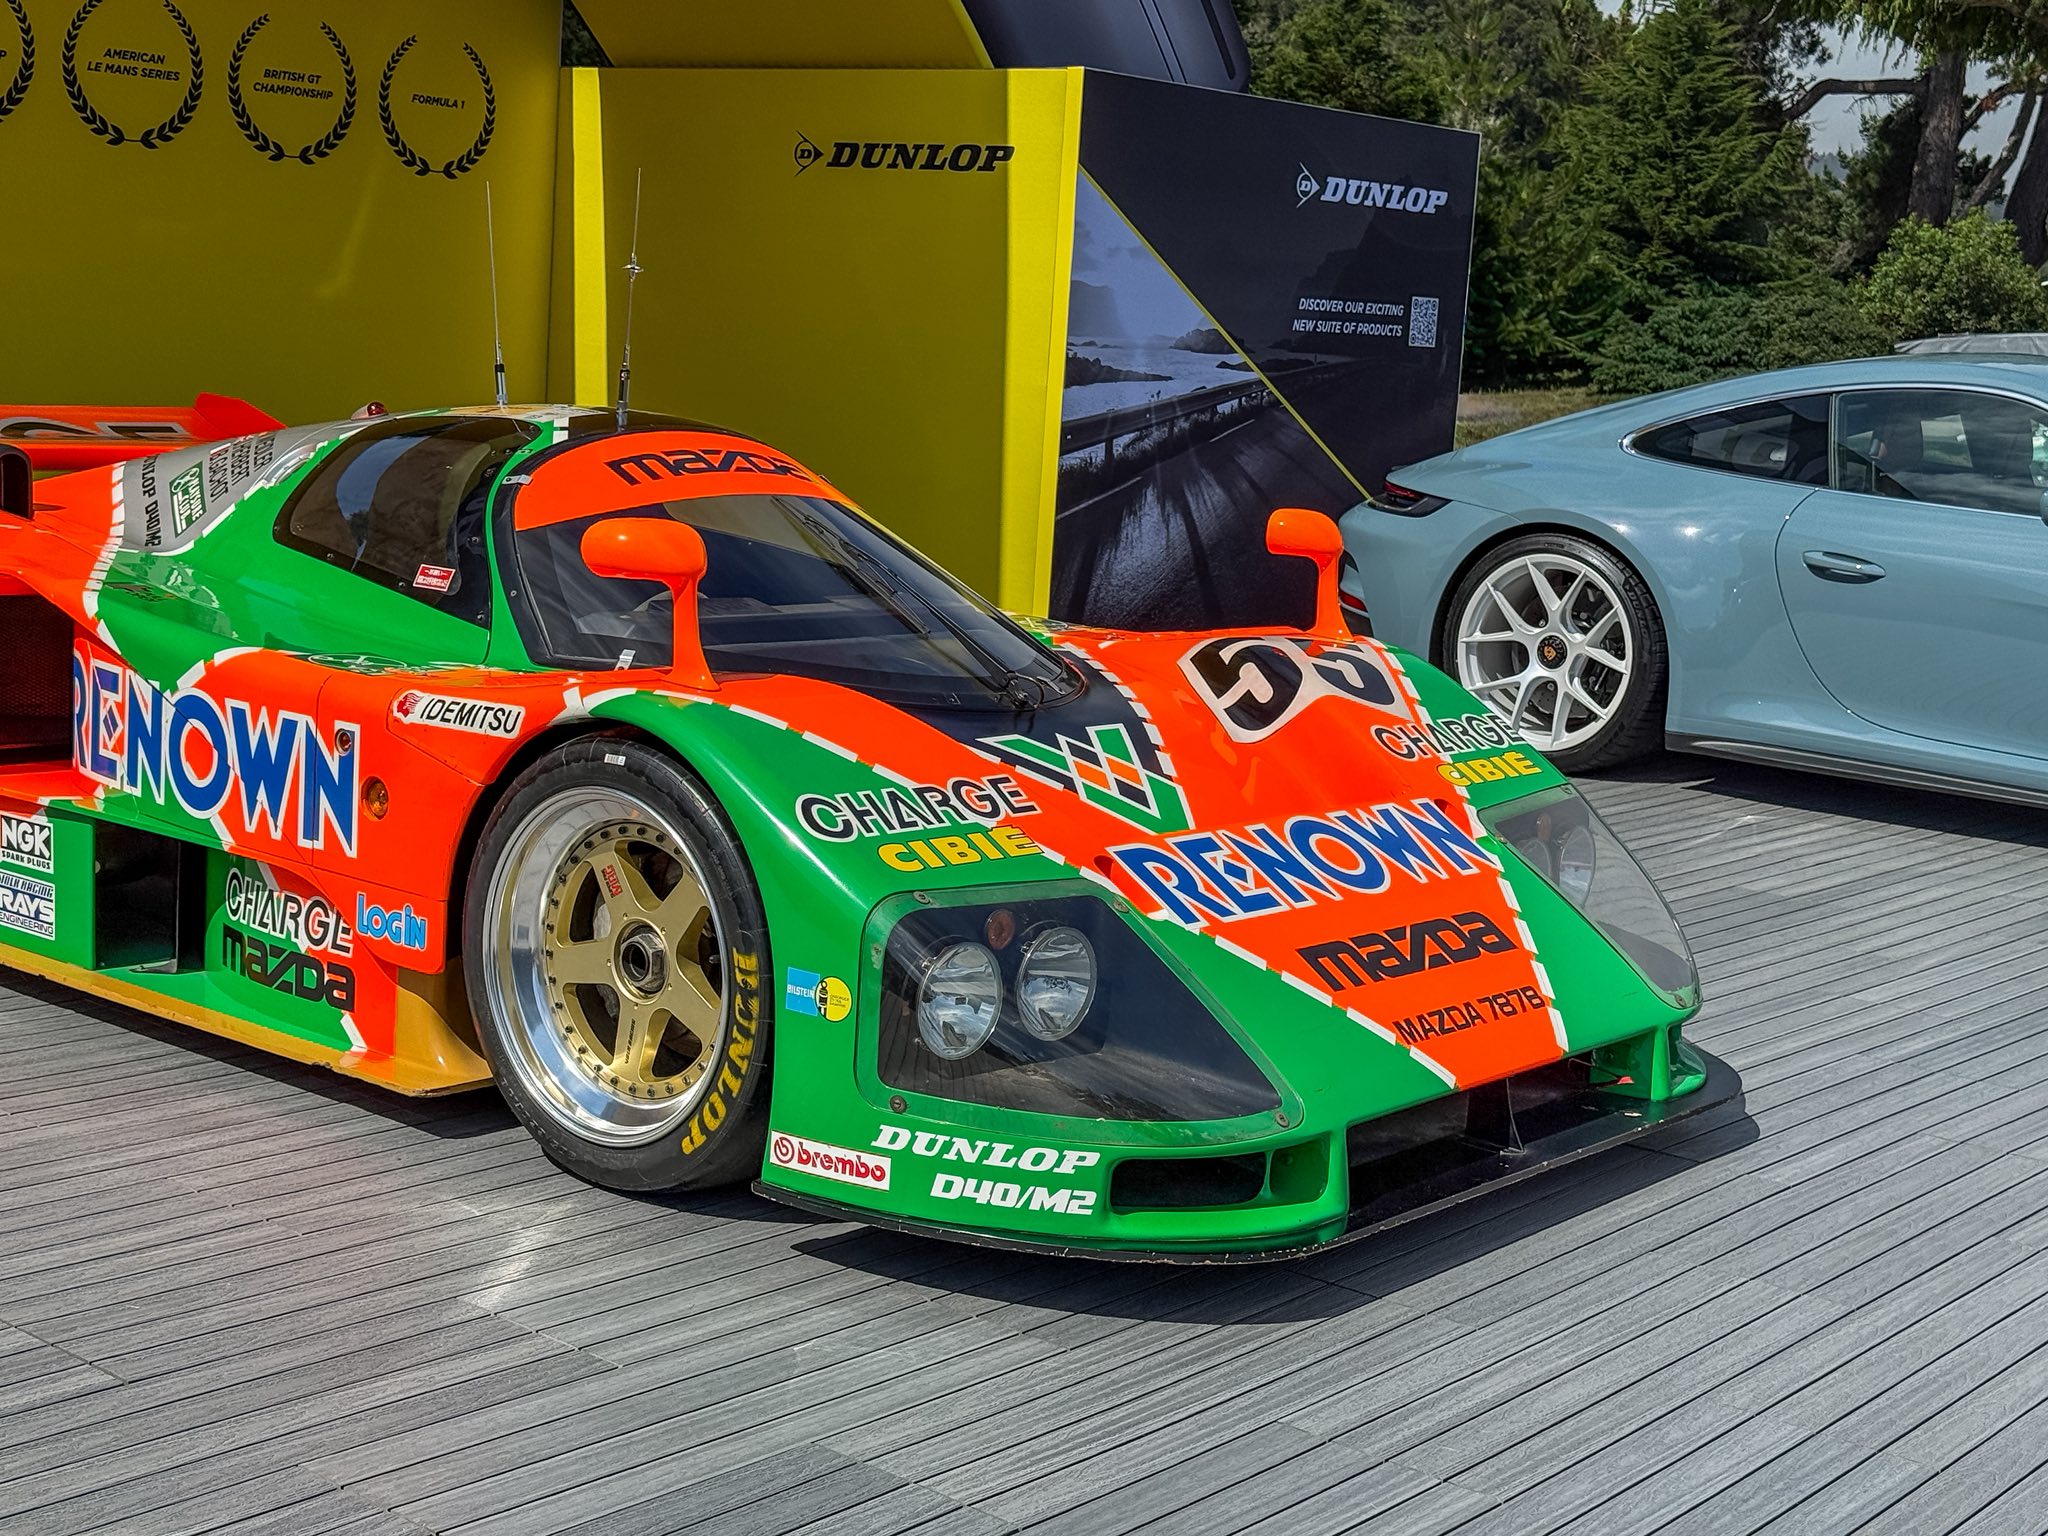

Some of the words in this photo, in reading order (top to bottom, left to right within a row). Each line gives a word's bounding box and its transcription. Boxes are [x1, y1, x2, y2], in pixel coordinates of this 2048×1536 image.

[87, 61, 101, 73] LE
[104, 63, 138, 77] MANS
[141, 68, 180, 81] SERIES
[104, 48, 165, 64] AMERICAN
[253, 82, 334, 100] CHAMPIONSHIP
[263, 69, 304, 83] BRITISH
[307, 74, 322, 85] GT
[411, 93, 458, 109] FORMULA
[460, 101, 465, 109] 1
[826, 142, 1015, 172] DUNLOP
[1320, 176, 1448, 214] DUNLOP
[1299, 298, 1343, 313] DISCOVER
[1345, 301, 1363, 314] OUR
[1365, 303, 1404, 316] EXCITING
[1292, 319, 1316, 332] NEW
[1316, 321, 1342, 333] SUITE
[1343, 322, 1356, 334] OF
[1357, 323, 1402, 337] PRODUCTS
[420, 697, 521, 734] IDEMITSU
[1373, 713, 1527, 760] CHARGE
[73, 655, 358, 857] RENOWN
[799, 776, 1040, 841] CHARGE
[2, 817, 51, 860] NGK
[2, 850, 26, 864] SPARK
[27, 855, 51, 870] PLUGS
[1110, 800, 1501, 928] RENOWN
[0, 887, 53, 922] RAYS
[0, 911, 53, 935] ENGINEERING
[227, 870, 353, 955] CHARGE
[1392, 1001, 1488, 1045] MAZDA
[1476, 985, 1546, 1021] 787B
[681, 947, 759, 1155] DUNLOP
[798, 1141, 886, 1182] brembo
[871, 1124, 1100, 1174] DUNLOP
[930, 1173, 1097, 1216] D40/M2
